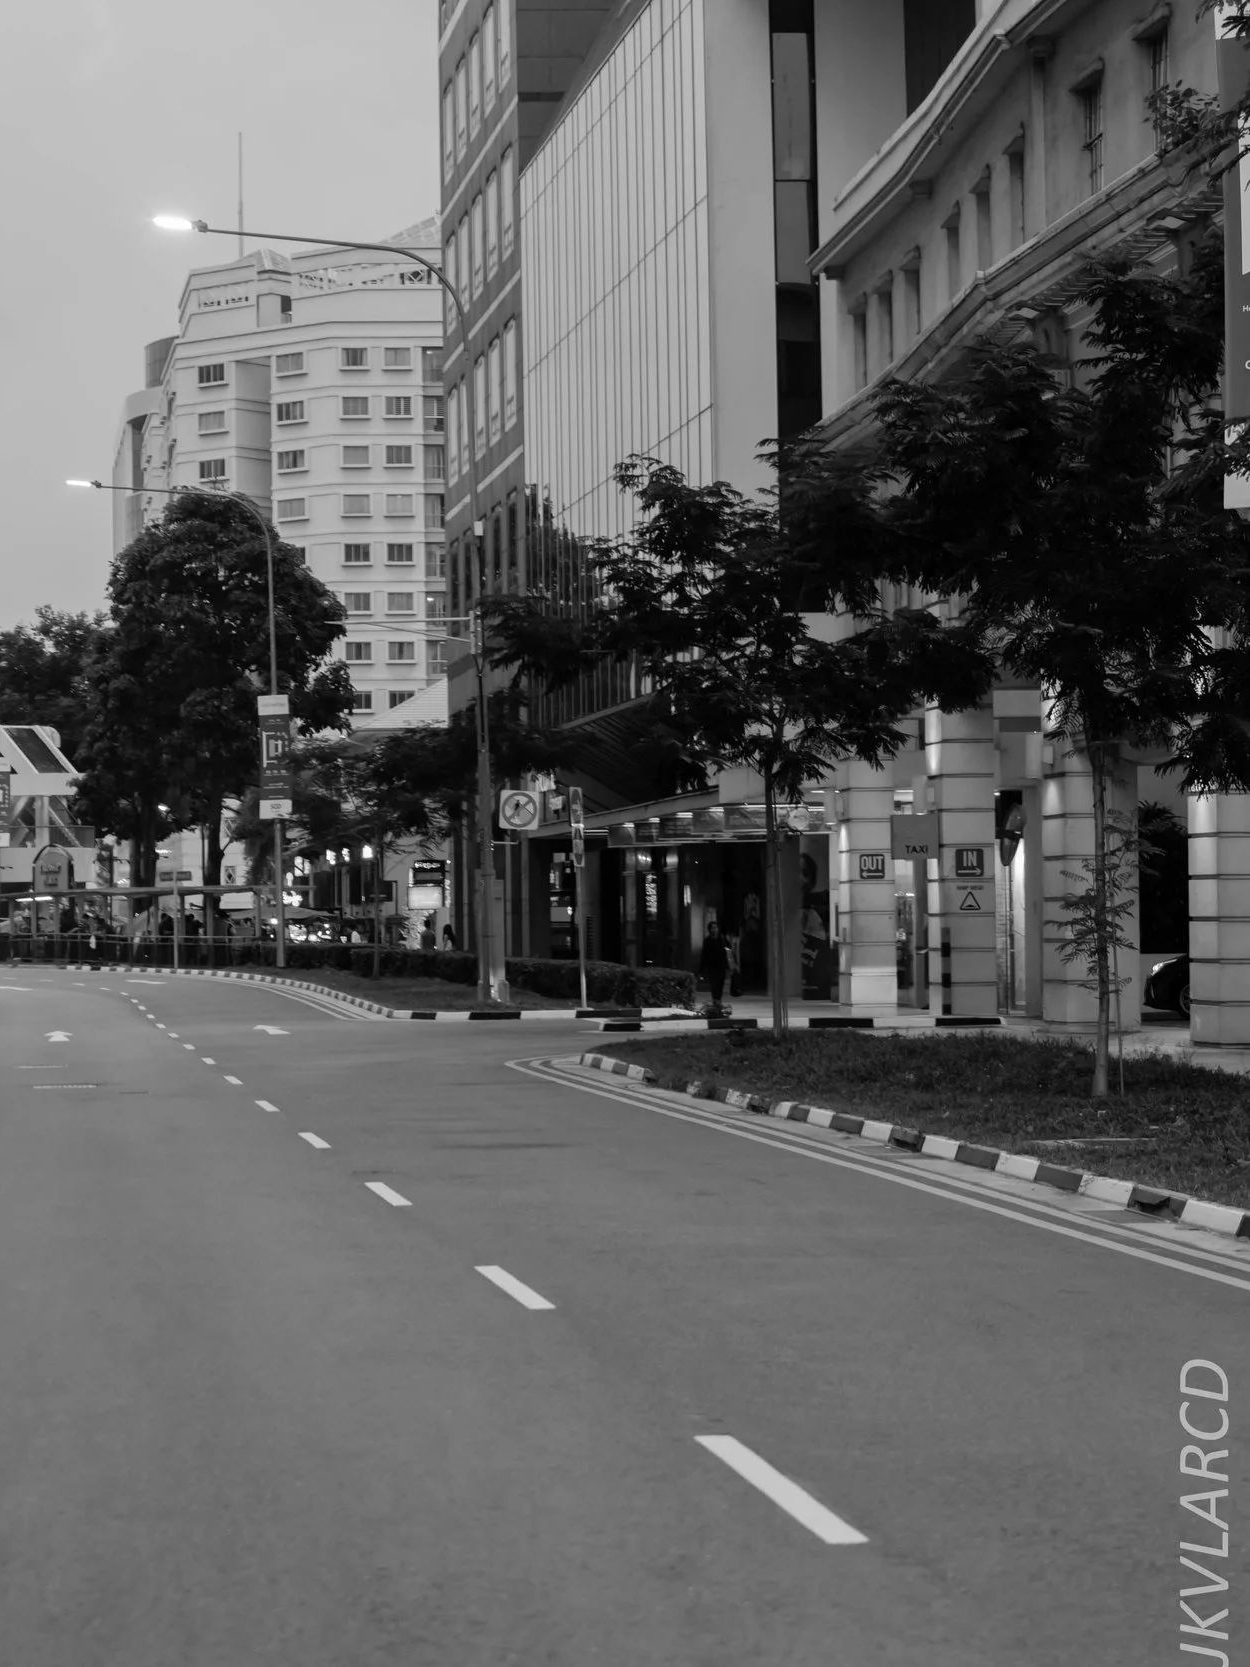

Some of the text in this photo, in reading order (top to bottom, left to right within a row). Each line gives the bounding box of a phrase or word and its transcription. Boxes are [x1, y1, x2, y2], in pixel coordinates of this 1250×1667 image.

[905, 845, 929, 854] TAXI
[861, 855, 884, 870] OUT
[963, 851, 978, 867] IN
